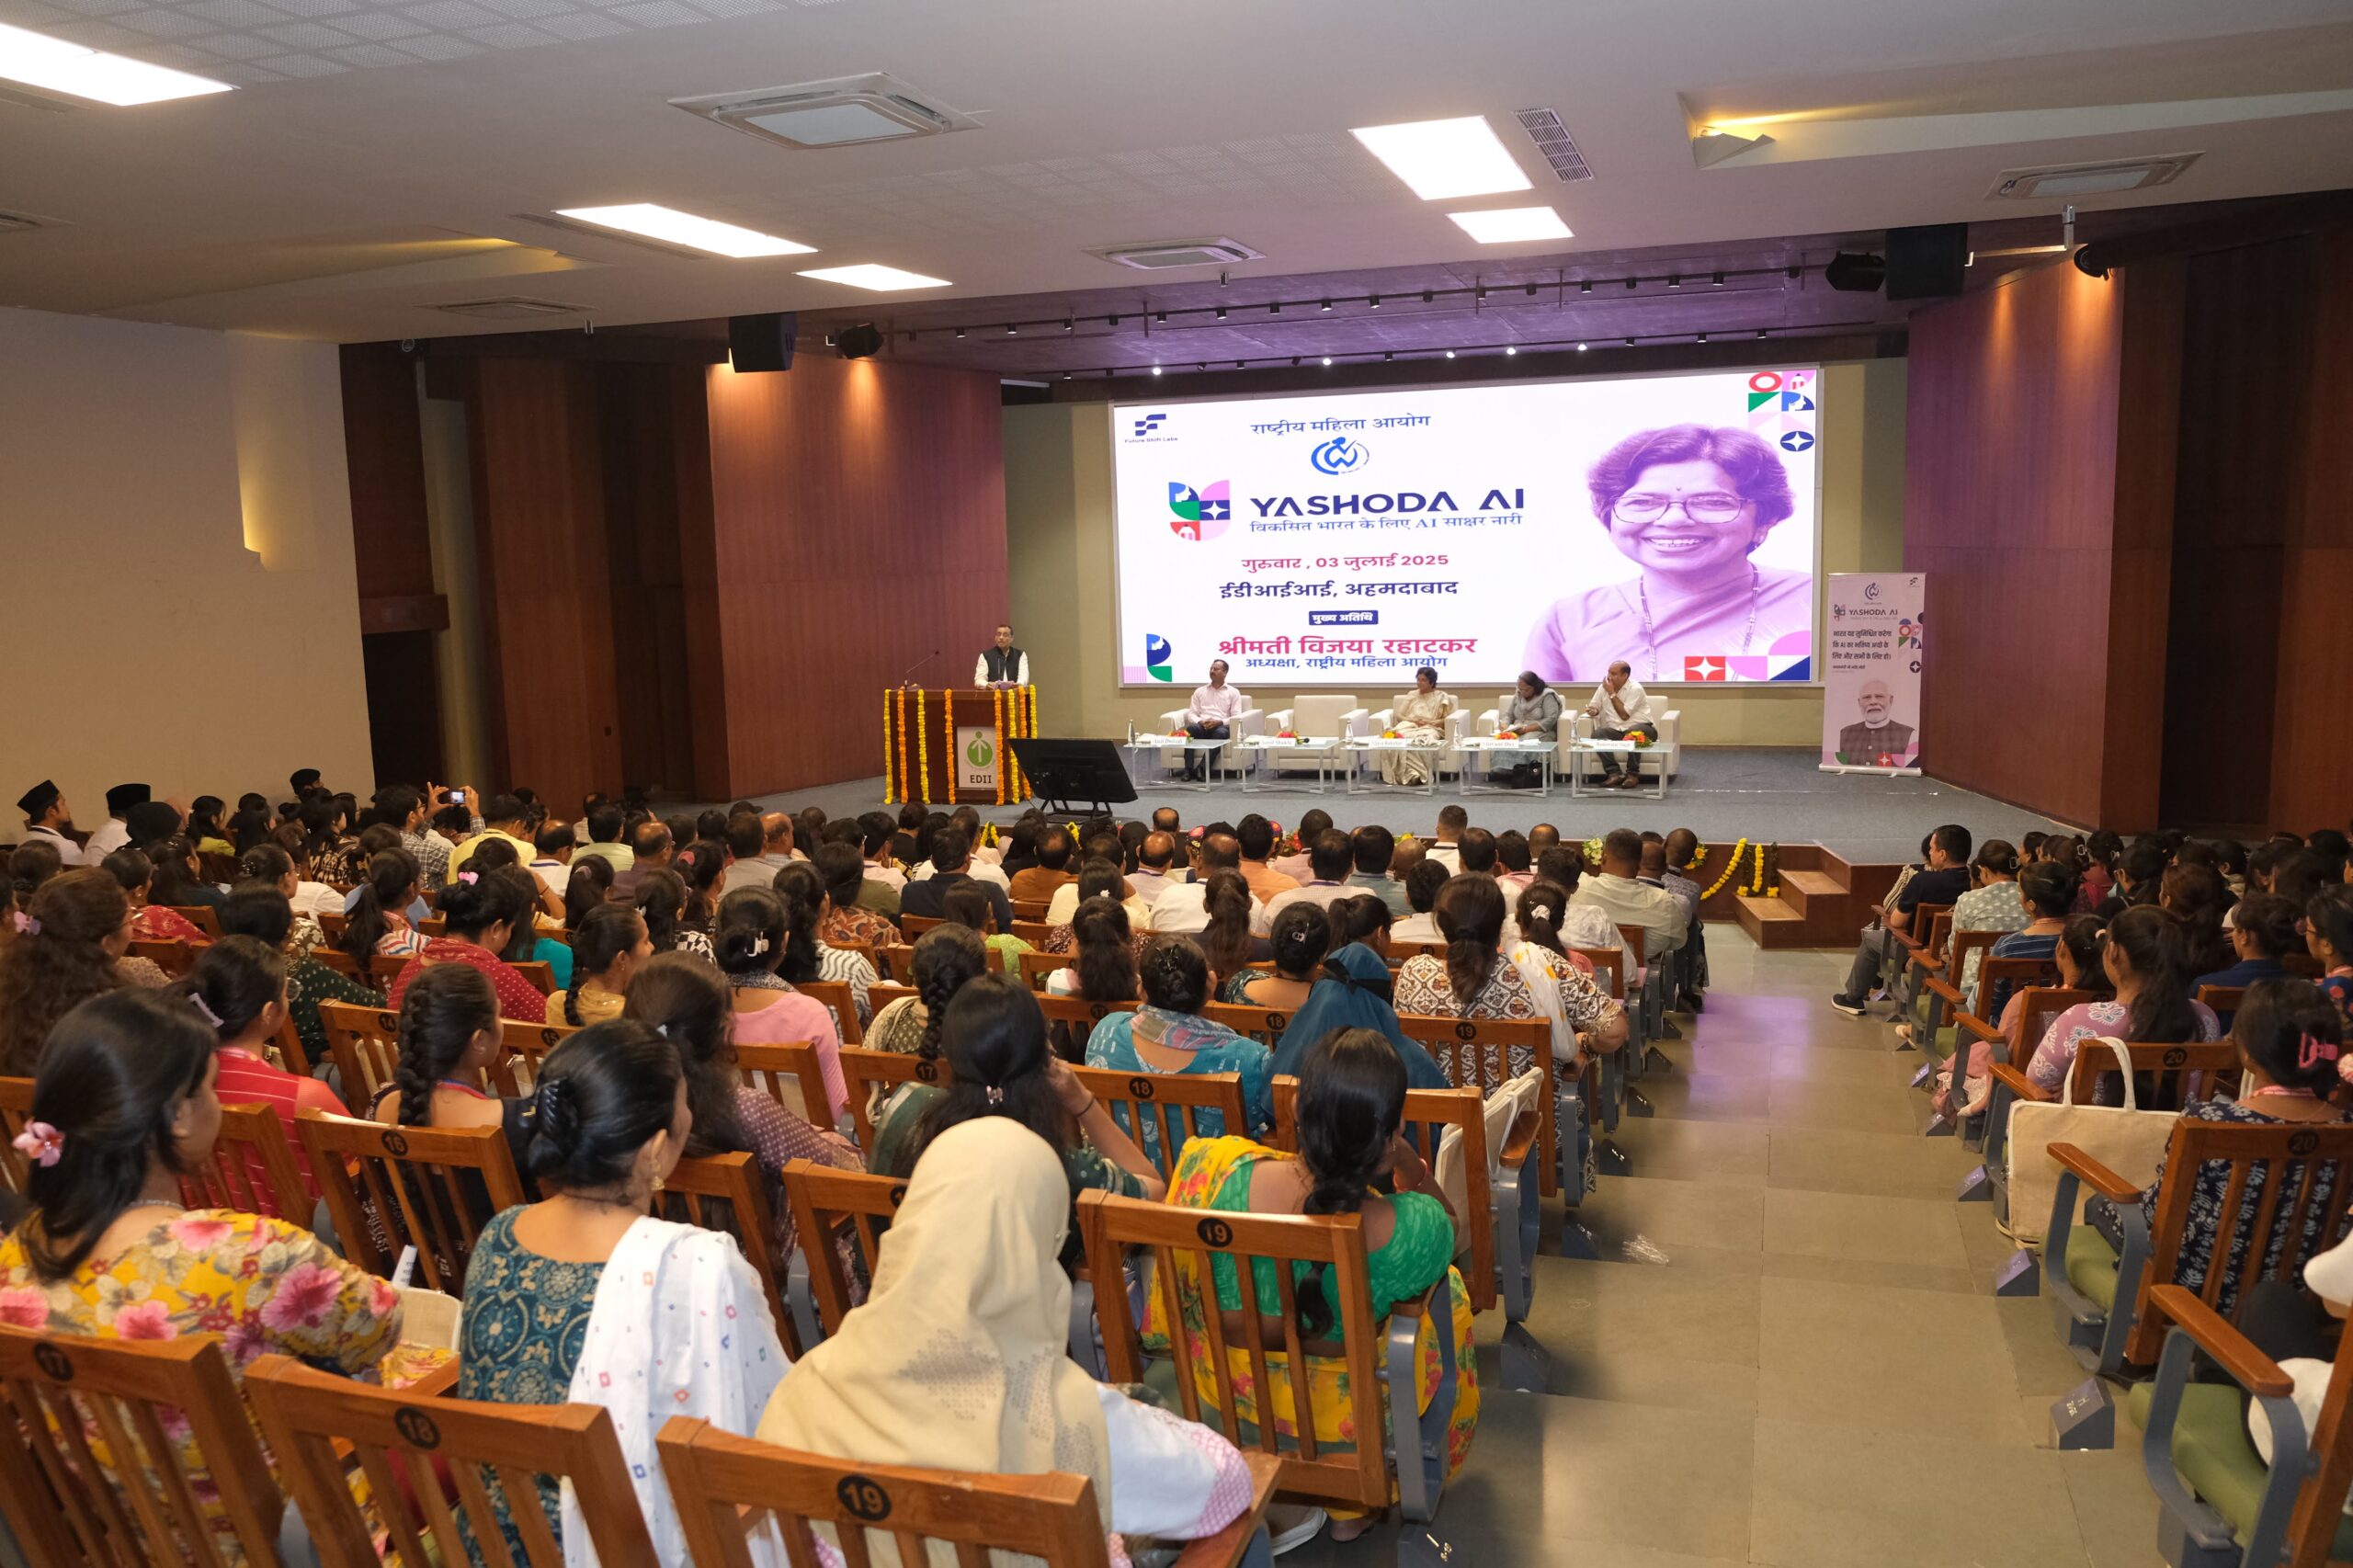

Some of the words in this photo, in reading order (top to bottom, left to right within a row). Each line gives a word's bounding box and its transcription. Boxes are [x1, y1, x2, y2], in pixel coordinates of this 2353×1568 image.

[1250, 419, 1306, 436] राष्ट्रीय
[1310, 417, 1366, 431] महिला
[1372, 413, 1432, 429] आयोग
[1250, 491, 1459, 517] YASHODA
[1478, 488, 1524, 511] AI
[1250, 518, 1312, 532] विकसित
[1317, 518, 1354, 531] भारत
[1359, 517, 1375, 529] के
[1379, 517, 1411, 529] लिए
[1416, 517, 1437, 528] AI
[1443, 515, 1486, 528] साक्षर
[1491, 512, 1523, 526] नारी
[1241, 557, 1302, 574] गुरुवार
[1315, 557, 1339, 568] 03
[1343, 552, 1399, 572] जुलाई
[1401, 554, 1449, 566] 2025
[1219, 580, 1338, 598] ईडीआईआई,
[1345, 581, 1460, 596] अहमदाबाद
[1312, 613, 1337, 625] मुख्य
[1339, 611, 1374, 623] अतिथि
[1218, 635, 1291, 655] श्रीमती
[1298, 635, 1374, 654] विजया
[1381, 639, 1478, 653] रहाटकर
[1305, 655, 1346, 669] राष्ट्रीय
[1350, 655, 1396, 668] महिला
[1401, 654, 1449, 668] आयोग
[970, 774, 992, 784] EDII
[1267, 1015, 1284, 1028] 18
[1459, 1025, 1474, 1038] 19
[2165, 1051, 2185, 1064] 20
[919, 1065, 934, 1078] 17
[1131, 1081, 1151, 1096] 18
[385, 1135, 405, 1153] 16
[1203, 1221, 1228, 1243] 19
[402, 1415, 435, 1444] 18
[845, 1483, 884, 1515] 19
